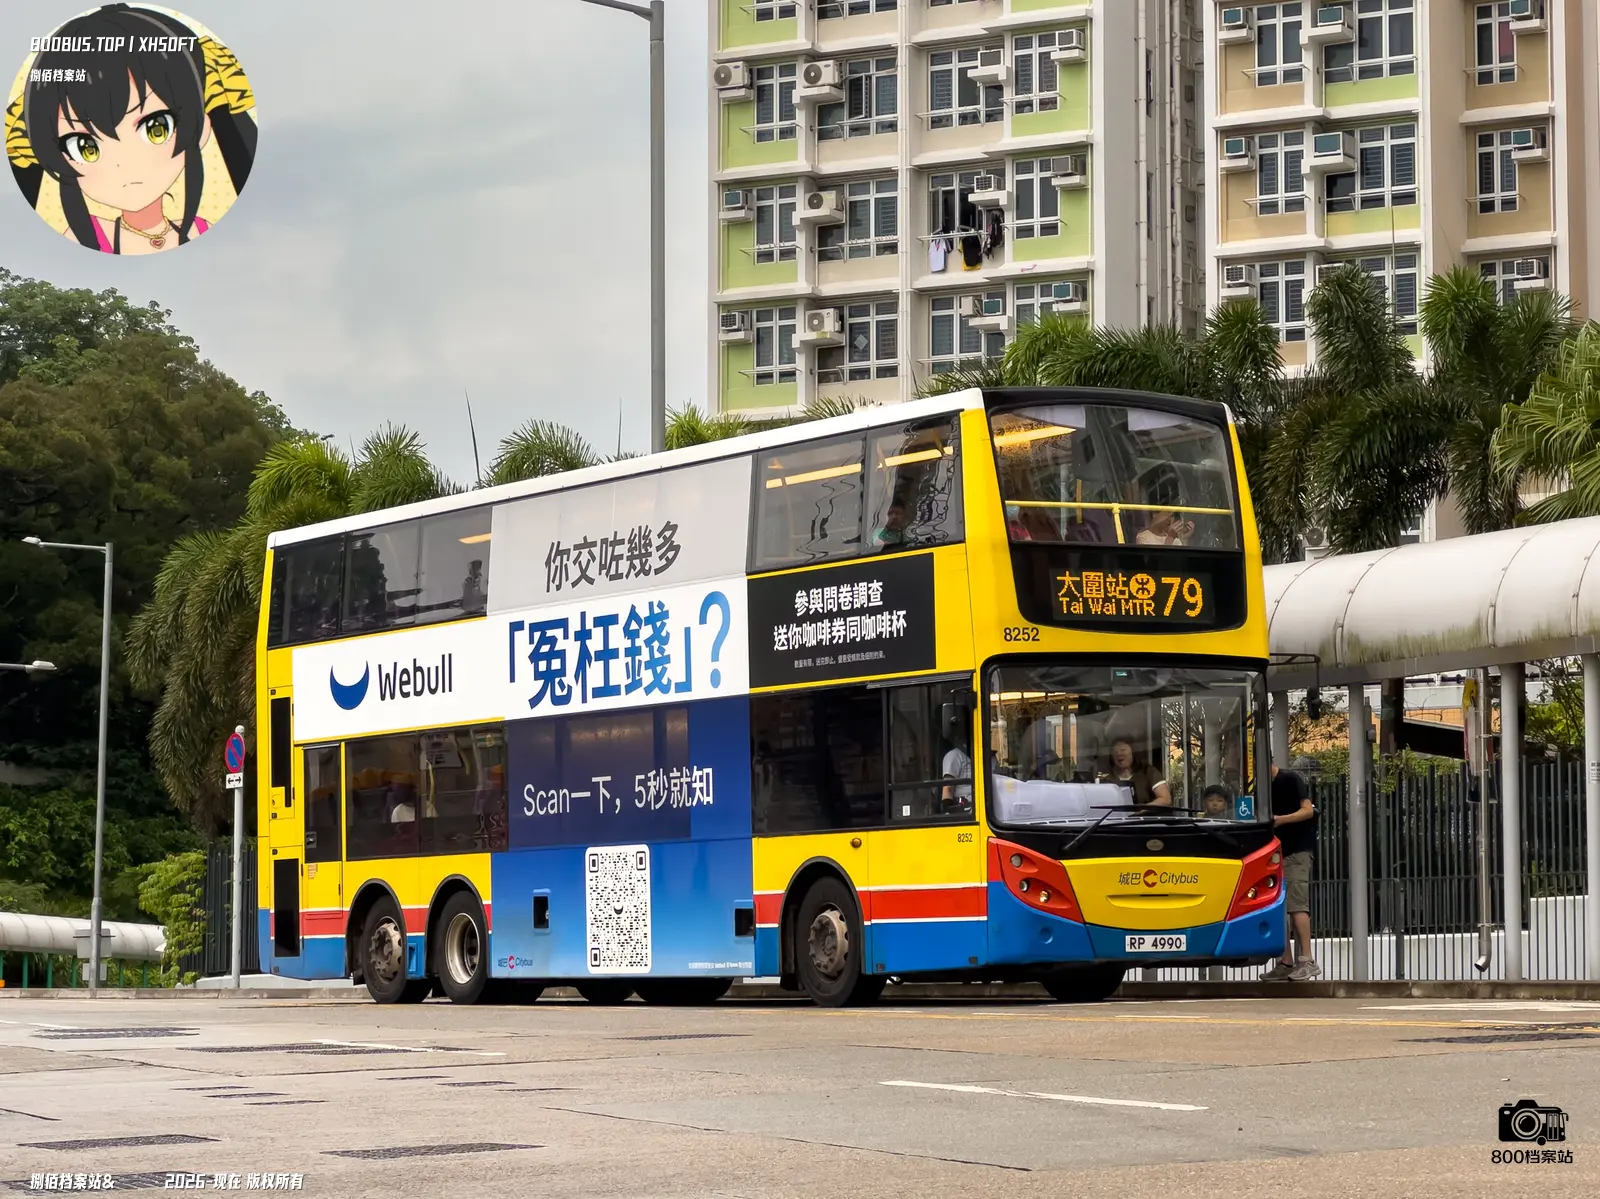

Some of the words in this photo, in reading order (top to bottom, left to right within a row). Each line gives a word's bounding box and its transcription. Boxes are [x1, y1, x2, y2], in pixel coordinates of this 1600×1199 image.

[544, 520, 682, 593] 你交咗幾多
[794, 579, 884, 617] 參與問卷調查
[1056, 571, 1129, 599] 大圍站
[1161, 576, 1204, 617] 79
[1059, 598, 1084, 615] Tai
[1088, 598, 1117, 616] Wai
[1121, 599, 1156, 617] MTR
[773, 610, 908, 652] 送你咖啡券同咖啡杯
[1003, 627, 1041, 642] 8252
[378, 653, 453, 701] Webull
[957, 833, 973, 843] 8252
[1118, 873, 1141, 886] 城巴
[1159, 871, 1199, 886] Citybus
[1129, 937, 1146, 950] RP
[1151, 937, 1183, 950] 4990
